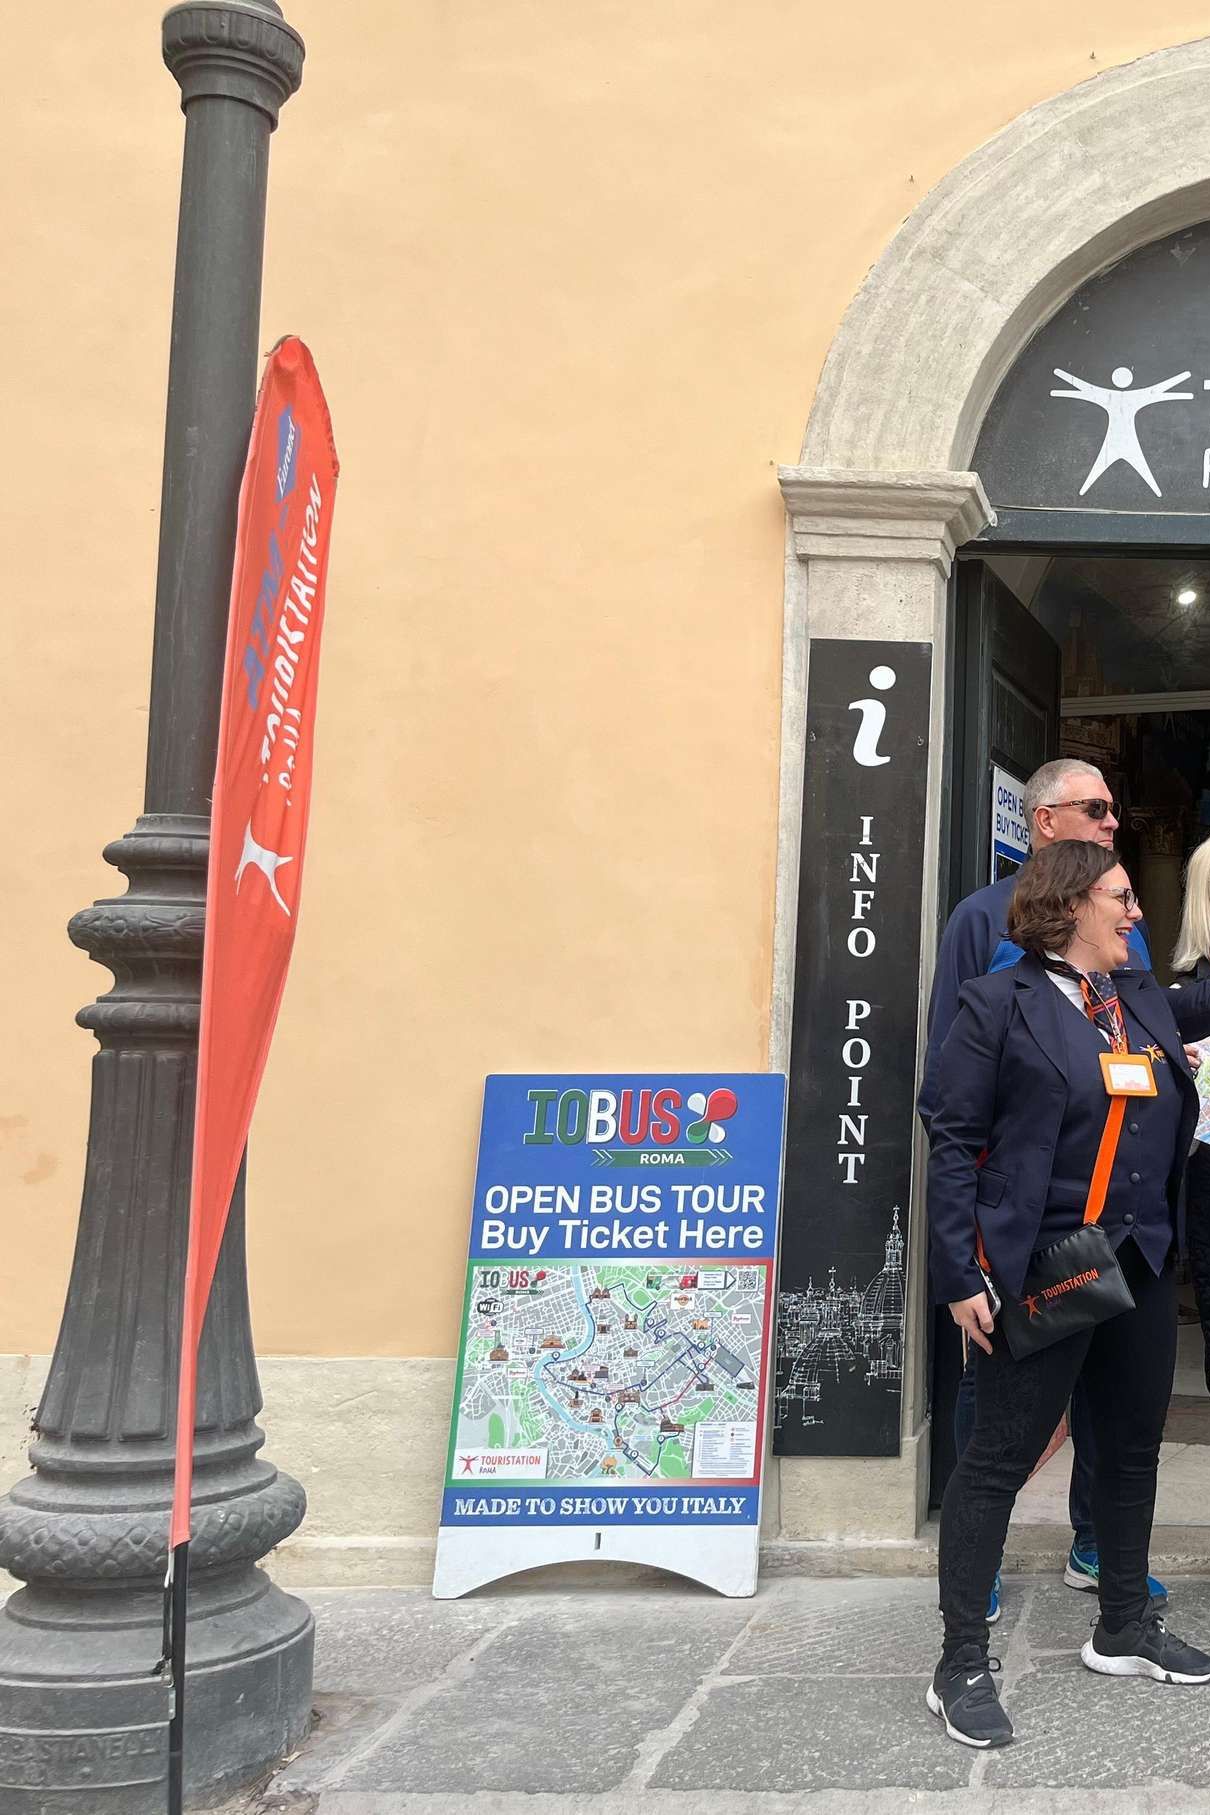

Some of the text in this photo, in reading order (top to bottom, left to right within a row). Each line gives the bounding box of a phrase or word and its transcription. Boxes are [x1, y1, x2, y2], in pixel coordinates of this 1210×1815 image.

[997, 786, 1018, 815] OPEN
[996, 813, 1029, 846] BUY TICKE
[837, 815, 879, 1184] INFO POINT
[523, 1088, 682, 1145] IOBUS
[639, 1153, 685, 1165] ROMA
[485, 1185, 765, 1214] OPEN BUS TOUR
[481, 1219, 764, 1255] Buy Ticket Here
[1041, 1268, 1099, 1299] TOURISTATION
[481, 1455, 541, 1465] TOURISTATION
[454, 1497, 746, 1516] MADE TO SHOW YOU ITALY
